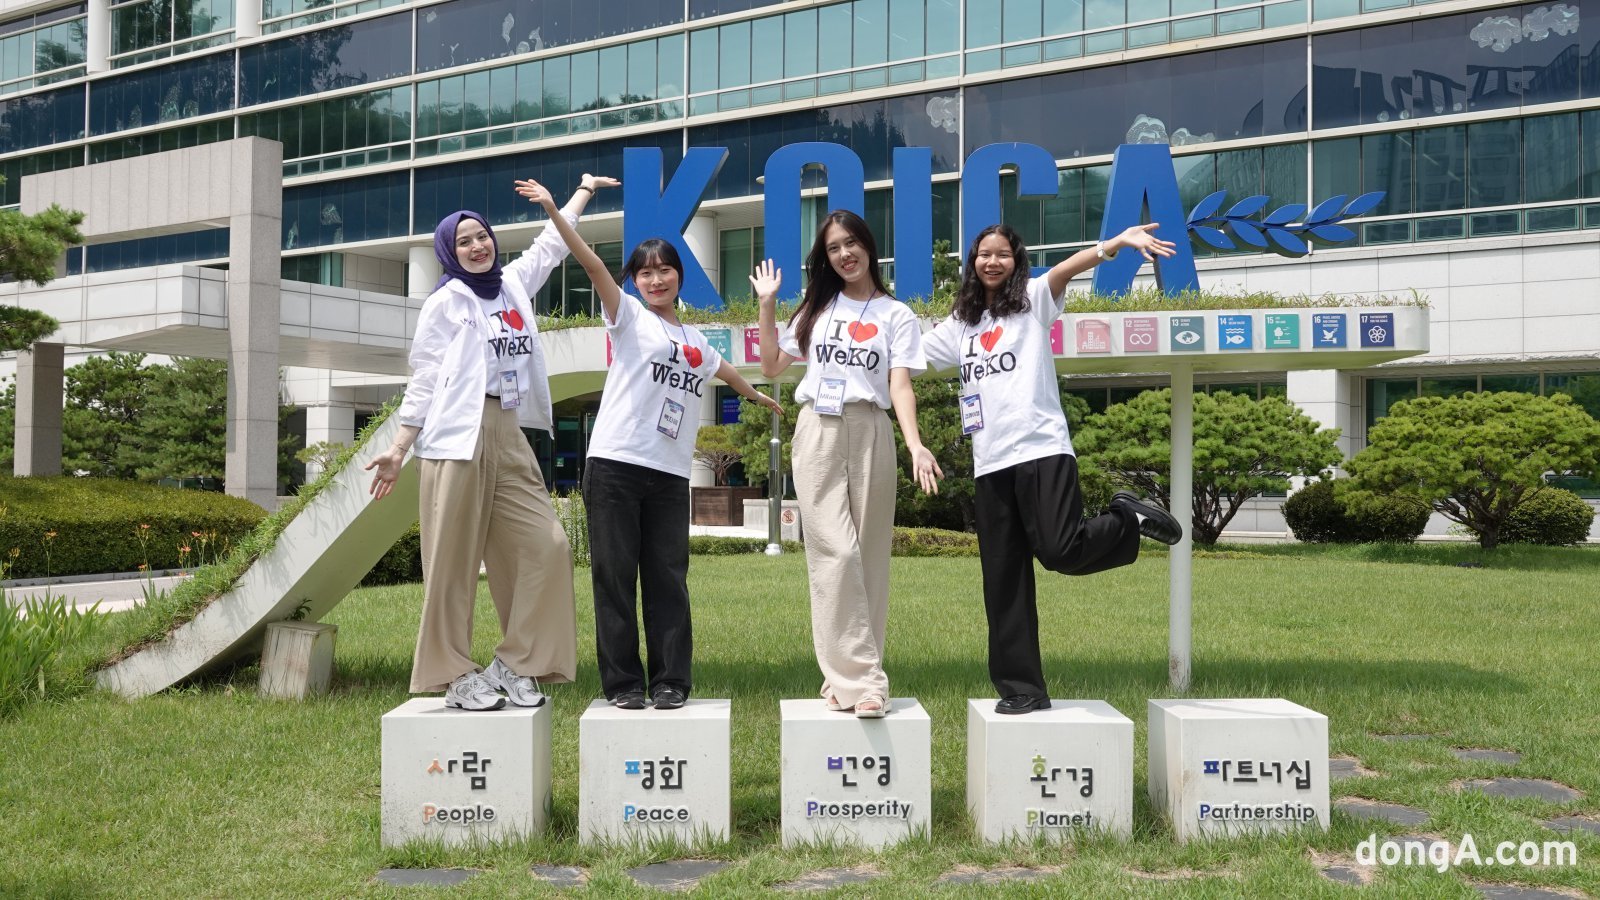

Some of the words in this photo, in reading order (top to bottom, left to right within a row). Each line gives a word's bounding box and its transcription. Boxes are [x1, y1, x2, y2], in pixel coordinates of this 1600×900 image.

[622, 141, 1199, 309] KOICA
[490, 310, 508, 333] I
[829, 319, 847, 341] I
[1125, 320, 1133, 328] 12
[1171, 319, 1179, 327] 13
[1219, 317, 1227, 325] 14
[1266, 316, 1274, 324] 15
[1313, 315, 1321, 323] 16
[1361, 315, 1368, 323] 17
[746, 330, 751, 338] 4
[488, 335, 533, 359] WeK
[669, 340, 680, 364] I
[965, 333, 979, 358] I
[816, 344, 880, 371] WeKO
[960, 351, 1017, 384] WeKO
[427, 751, 492, 790] 사람
[625, 756, 688, 791] 평화
[827, 755, 892, 787] 번영
[1030, 754, 1095, 799] 환경
[1203, 759, 1312, 790] 파트너십
[423, 803, 496, 824] People
[624, 803, 690, 823] Peace
[806, 799, 913, 821] Prosperity
[1026, 807, 1094, 828] Planet
[1199, 802, 1316, 824] Partnership
